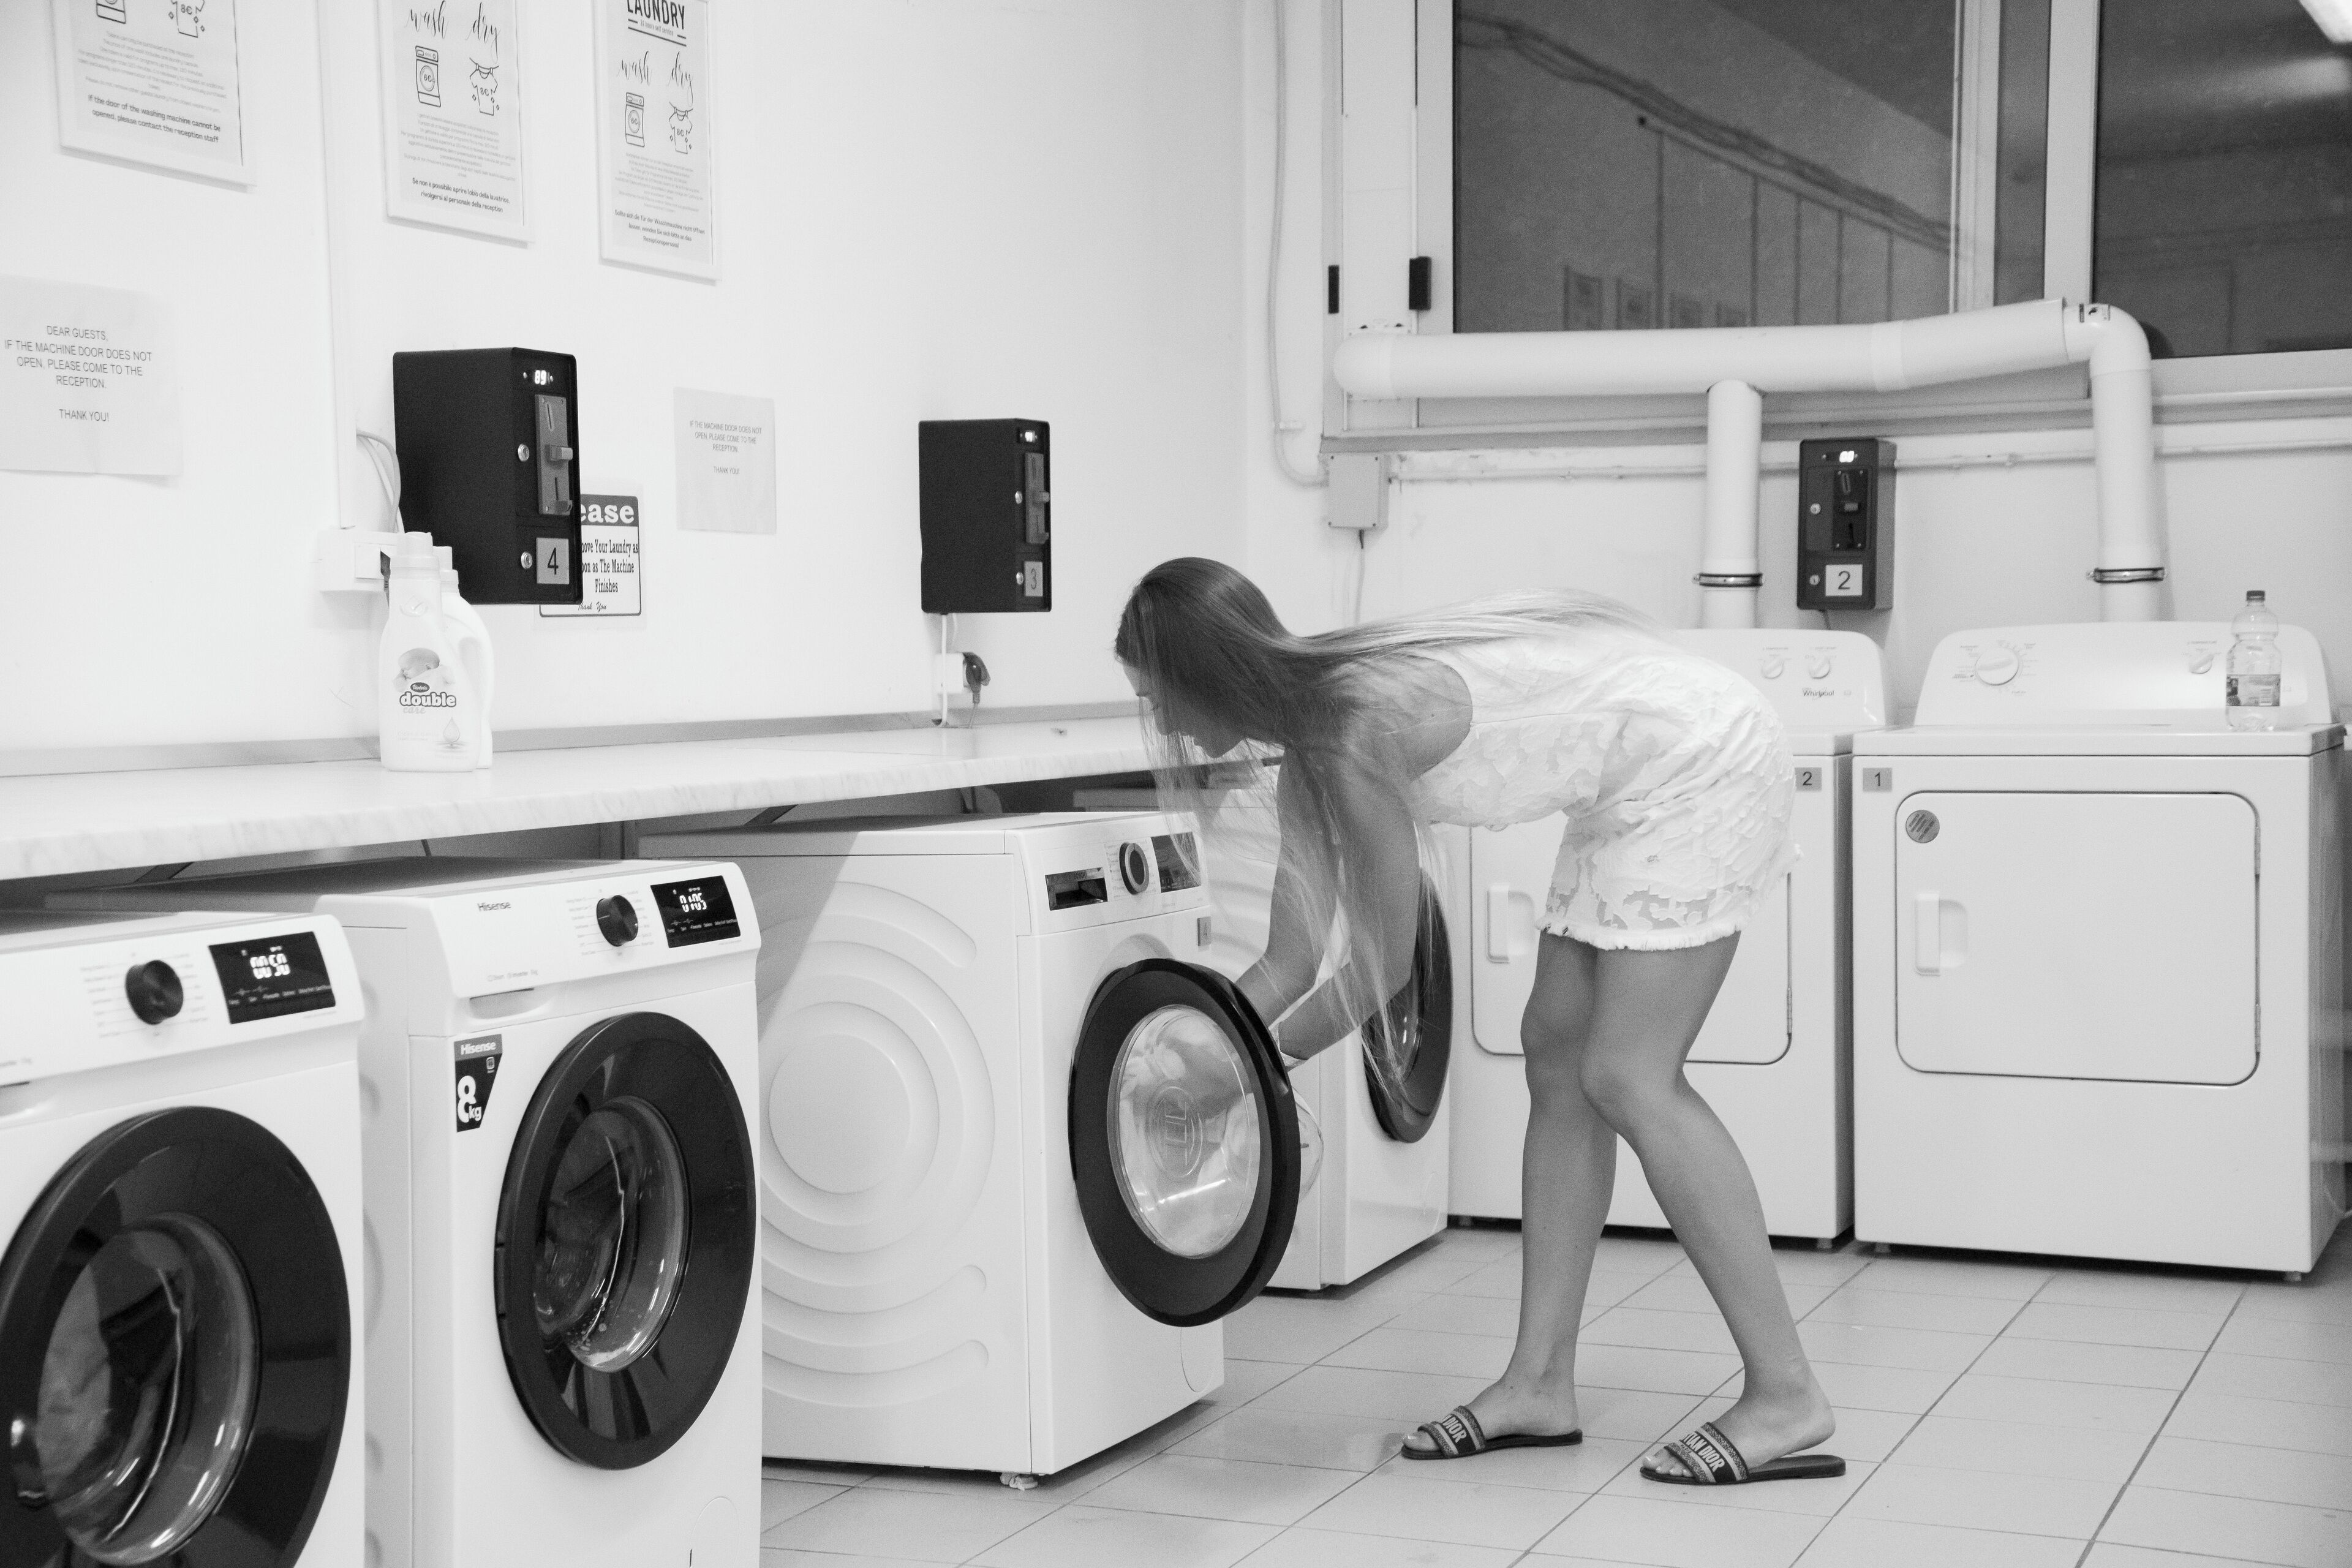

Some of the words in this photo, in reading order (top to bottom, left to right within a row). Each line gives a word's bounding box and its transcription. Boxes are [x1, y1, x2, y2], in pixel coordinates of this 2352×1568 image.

[404, 0, 448, 39] wash
[466, 2, 501, 64] dry
[617, 51, 652, 86] wash
[666, 51, 693, 107] dry
[105, 99, 120, 107] door
[141, 108, 165, 121] washing
[167, 114, 190, 125] machine
[192, 119, 213, 130] cannot
[213, 123, 221, 132] be
[117, 115, 137, 125] please
[138, 120, 162, 130] contact
[163, 124, 173, 134] the
[175, 128, 203, 140] reception
[204, 134, 219, 143] staff
[47, 325, 70, 336] DEAR
[72, 328, 108, 342] GUESTS,
[4, 339, 13, 350] IF
[15, 340, 33, 352] THE
[36, 342, 77, 356] MACHINE
[78, 345, 104, 358] DOOR
[106, 349, 130, 360] DOES
[133, 350, 153, 362] NOT
[17, 356, 45, 369] OPEN,
[47, 358, 81, 371] PLEASE
[83, 362, 108, 374] COME
[110, 364, 123, 375] TO
[124, 365, 143, 377] THE
[56, 375, 107, 389] RECEPTION.
[58, 409, 87, 420] THANK
[88, 411, 110, 422] YOU!
[695, 420, 704, 429] THE
[704, 422, 724, 431] MACHINE
[724, 423, 738, 432] DOOR
[738, 425, 752, 434] DOES
[752, 426, 762, 435] NOT
[709, 432, 726, 442] PLEASE
[726, 434, 739, 443] COME
[748, 436, 757, 445] THE
[713, 466, 729, 474] THANK
[594, 538, 608, 554] Your
[609, 538, 631, 558] Laundry
[633, 543, 638, 554] as
[547, 547, 559, 576] 4
[592, 562, 598, 573] as
[599, 558, 610, 573] The
[611, 558, 635, 573] Machine
[595, 578, 619, 593] Finishes
[1030, 567, 1038, 590] 3
[1838, 570, 1851, 590] 2
[596, 601, 607, 613] You
[399, 691, 457, 708] double
[1803, 689, 1834, 698] Whirlpool
[1802, 771, 1813, 786] 2
[1874, 772, 1881, 787] 1
[477, 902, 511, 912] Hisense
[460, 1041, 497, 1055] Hisense
[457, 1074, 477, 1123] 8
[469, 1105, 482, 1121] kg
[1442, 1416, 1467, 1444] DIOR
[1698, 1445, 1725, 1472] DIOR
